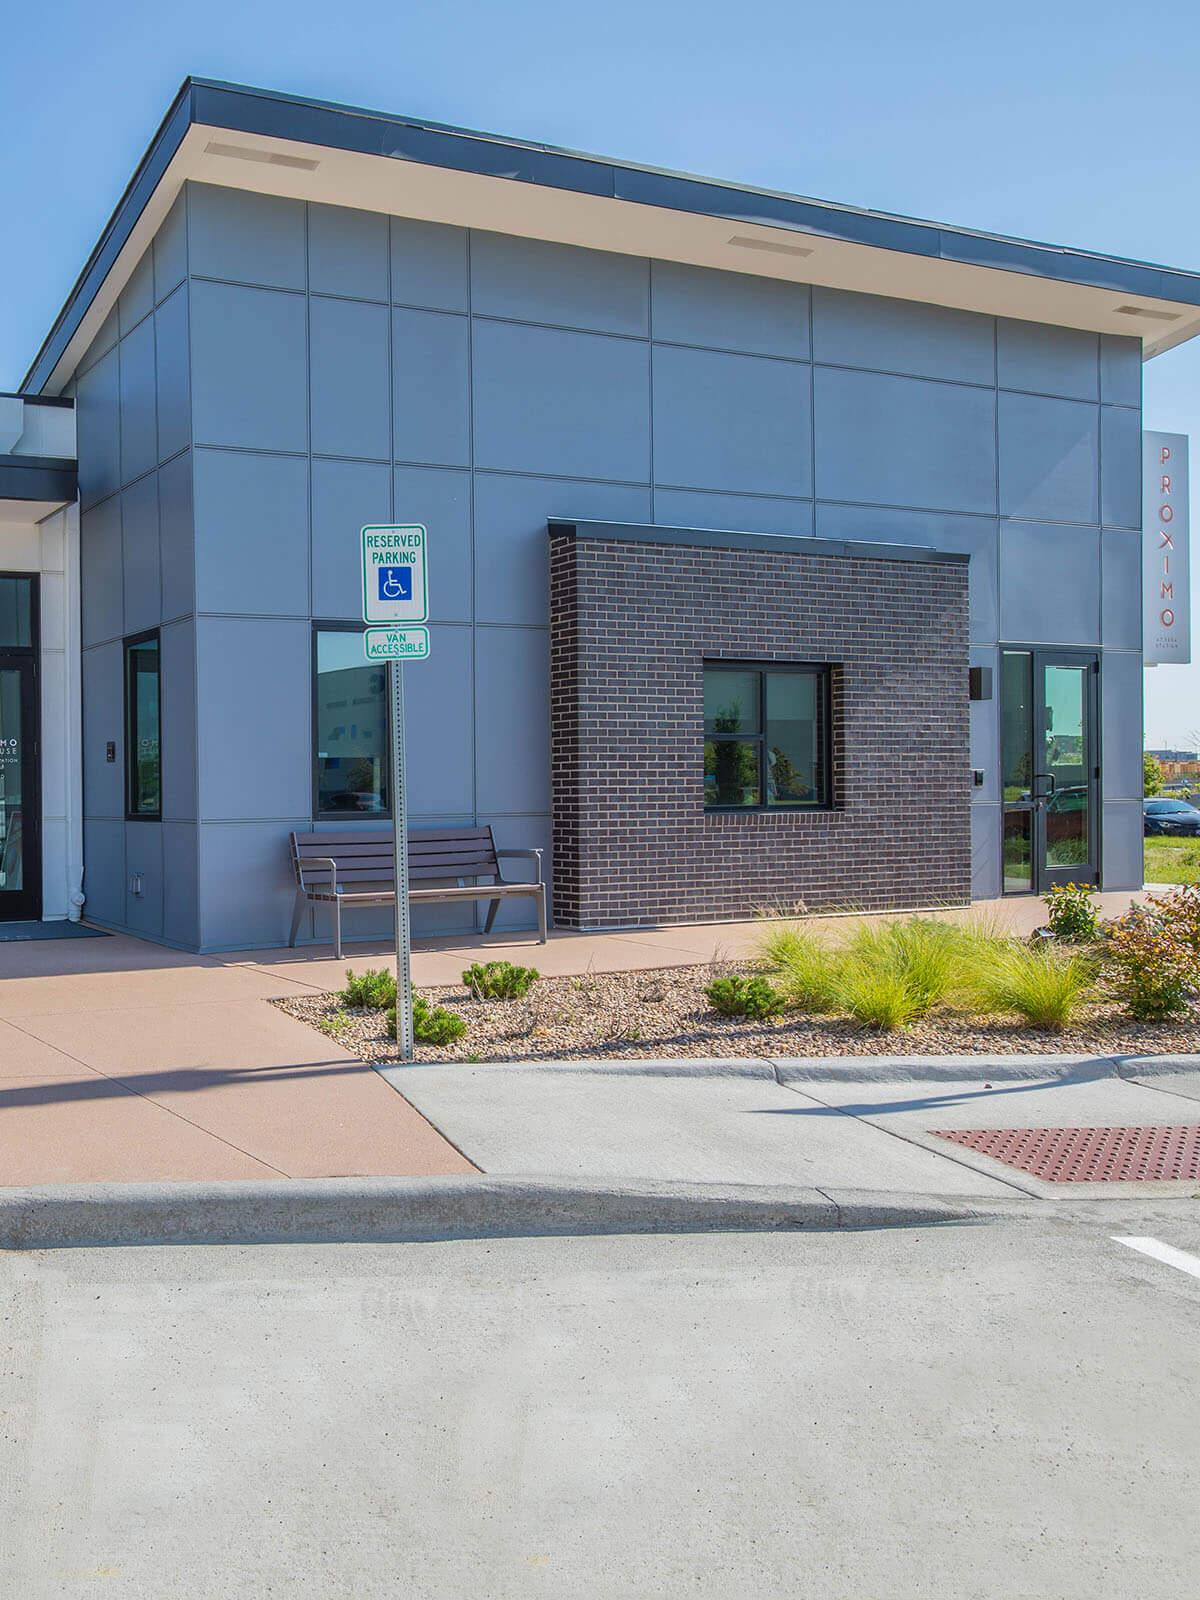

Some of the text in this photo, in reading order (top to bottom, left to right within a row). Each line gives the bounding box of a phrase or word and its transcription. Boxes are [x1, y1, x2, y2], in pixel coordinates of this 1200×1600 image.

[367, 535, 421, 548] RESERVED
[1159, 447, 1174, 627] PROXIMO
[372, 551, 416, 564] PARKING
[386, 633, 406, 643] VAN
[370, 643, 424, 654] ACCESSIBLE
